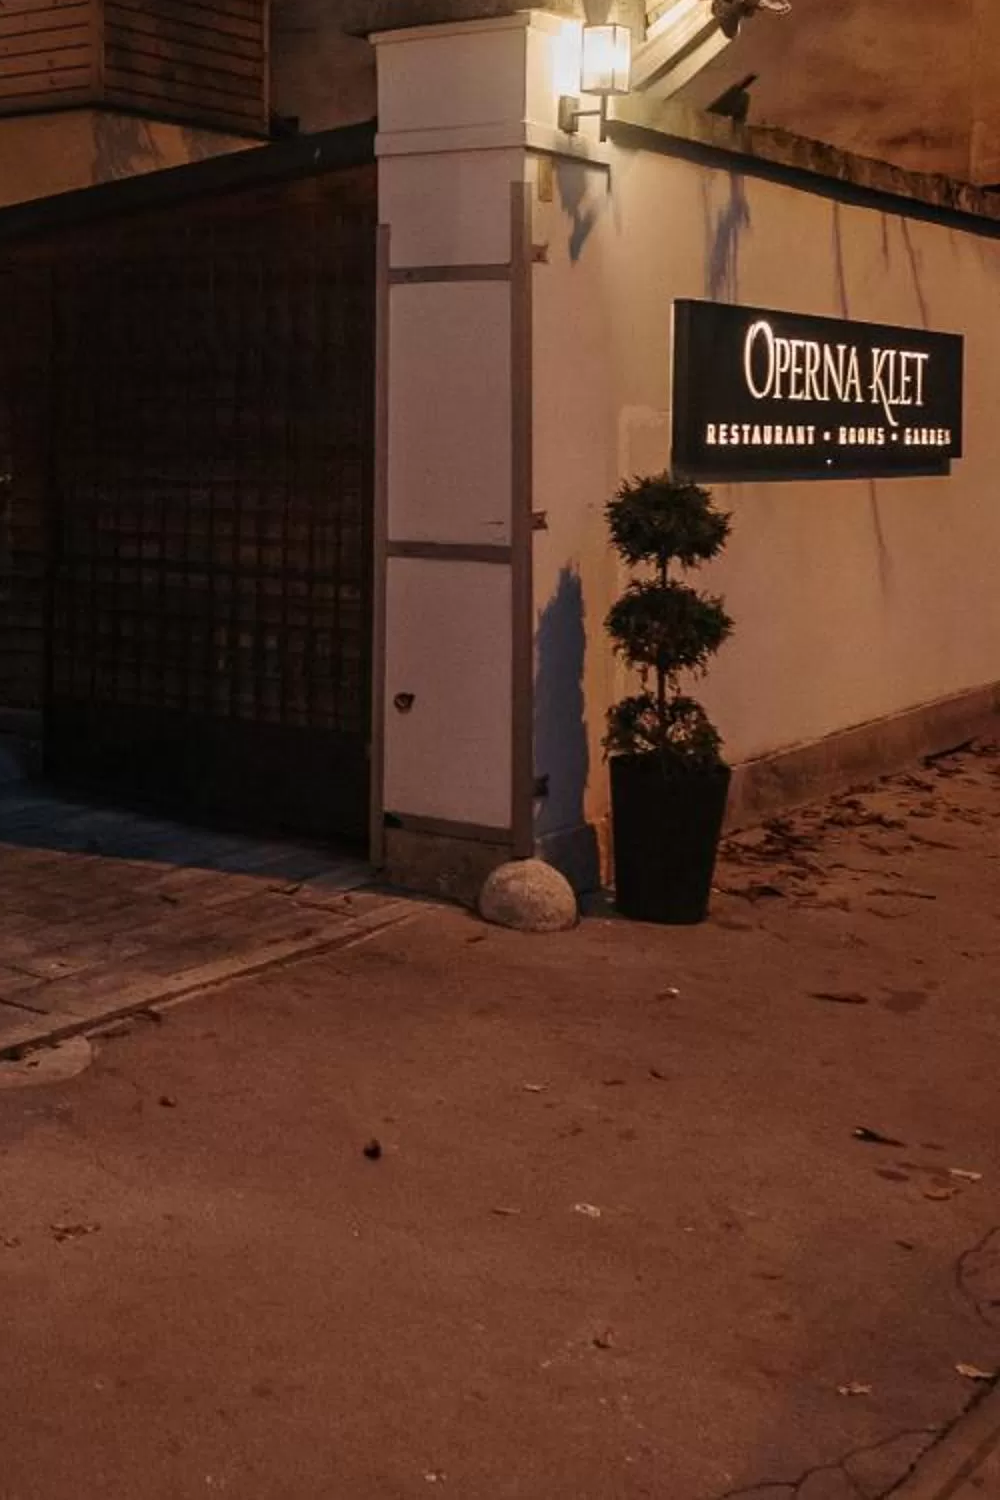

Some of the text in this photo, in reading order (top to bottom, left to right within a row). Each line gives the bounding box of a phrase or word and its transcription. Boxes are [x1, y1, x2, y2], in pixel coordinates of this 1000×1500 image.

[744, 320, 929, 426] OPERNA KLET
[706, 423, 816, 446] RESTAURANT
[838, 426, 885, 446] ROOMS
